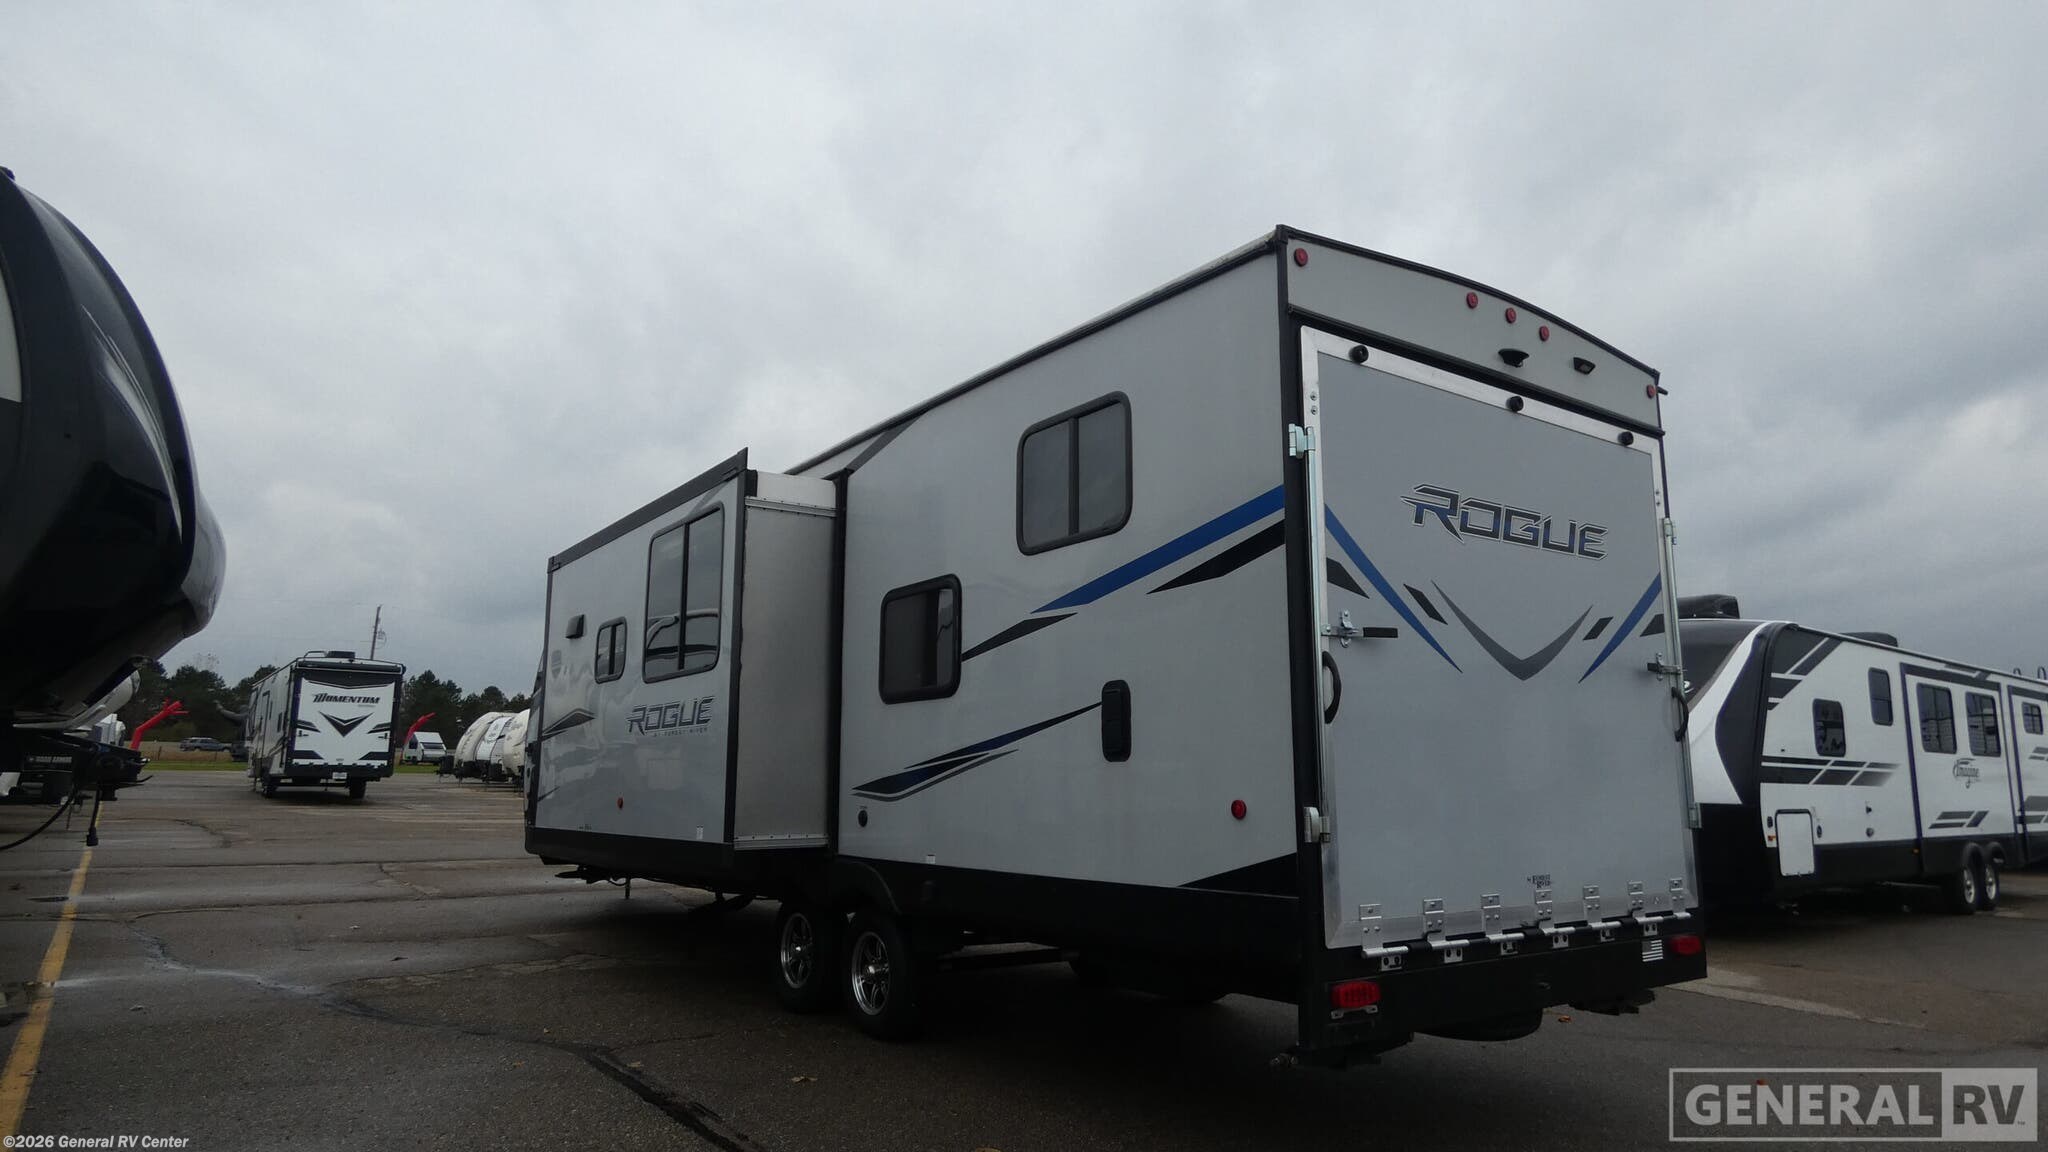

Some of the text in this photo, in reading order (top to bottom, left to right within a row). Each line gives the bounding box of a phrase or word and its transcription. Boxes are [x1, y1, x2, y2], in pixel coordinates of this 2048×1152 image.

[1400, 483, 1608, 561] ROGUE
[312, 692, 381, 704] MOMENTUM
[626, 695, 716, 736] ROGUE
